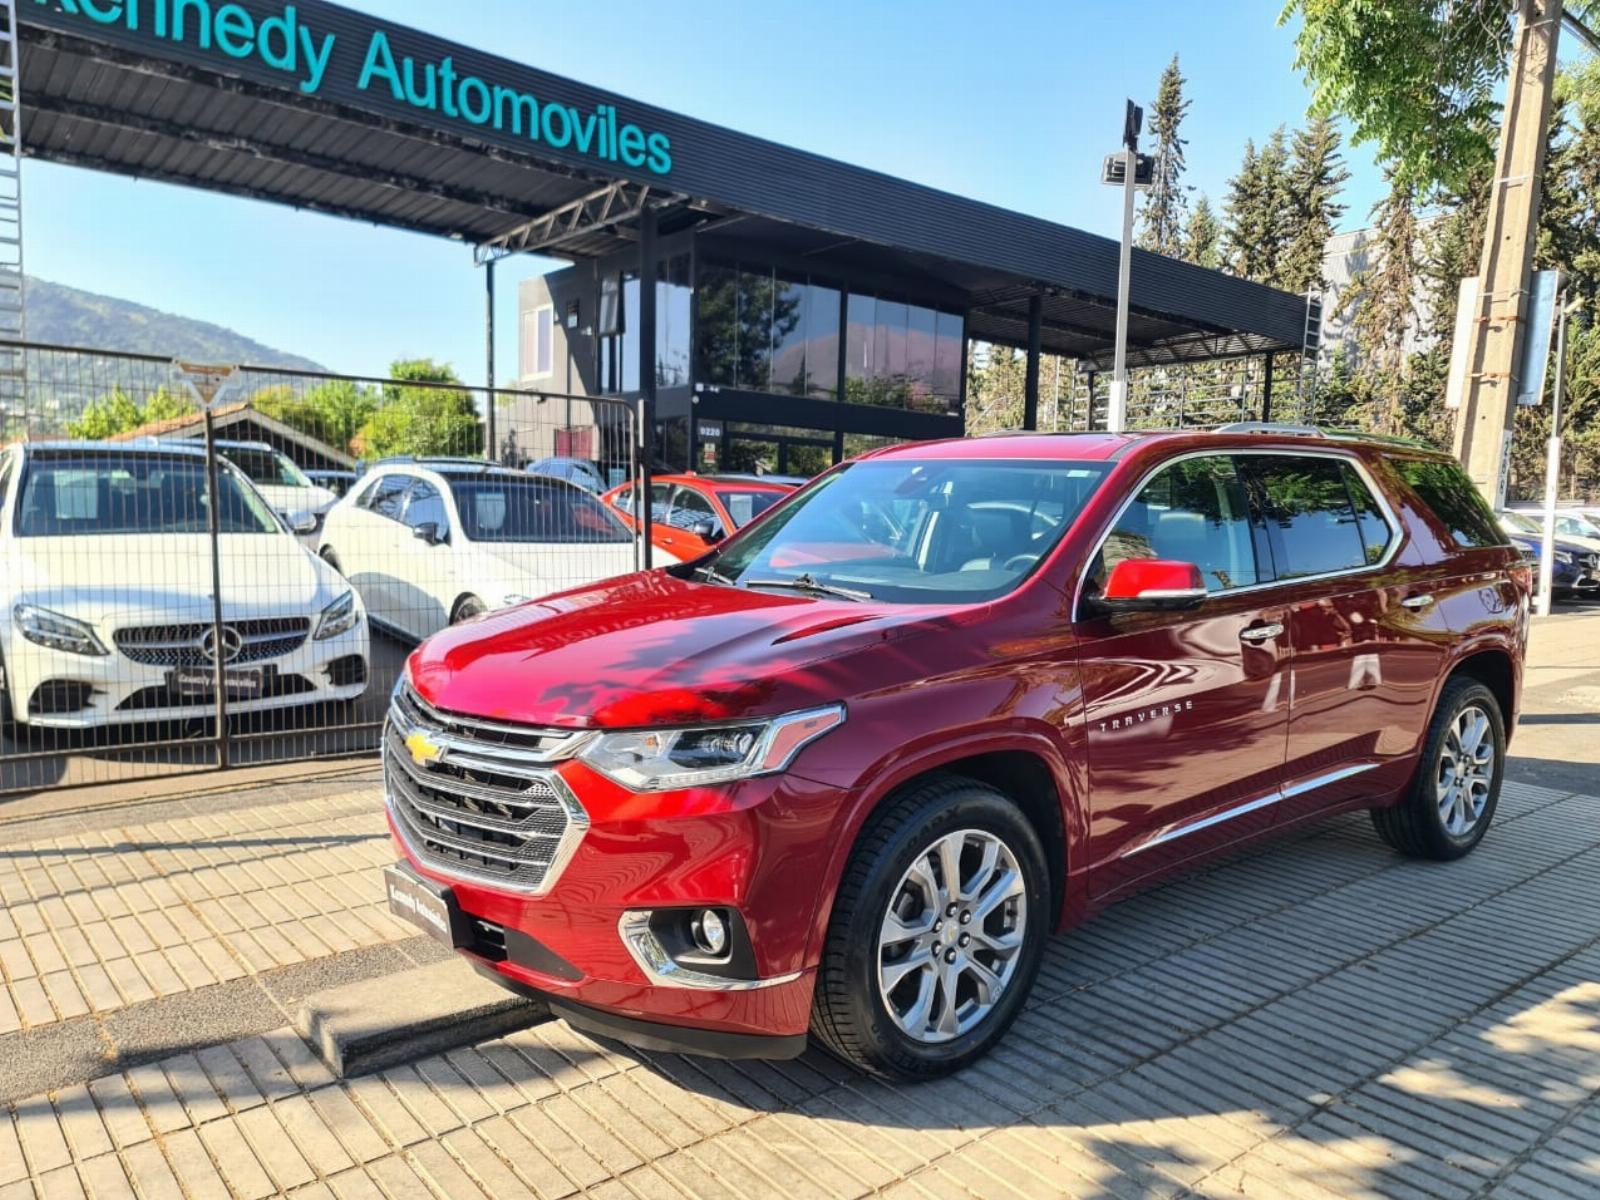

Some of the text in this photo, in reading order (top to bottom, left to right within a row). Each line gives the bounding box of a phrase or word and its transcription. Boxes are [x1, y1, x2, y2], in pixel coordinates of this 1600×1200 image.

[34, 0, 672, 174] ennedy Automoviles
[1100, 700, 1193, 732] TRAVERSE
